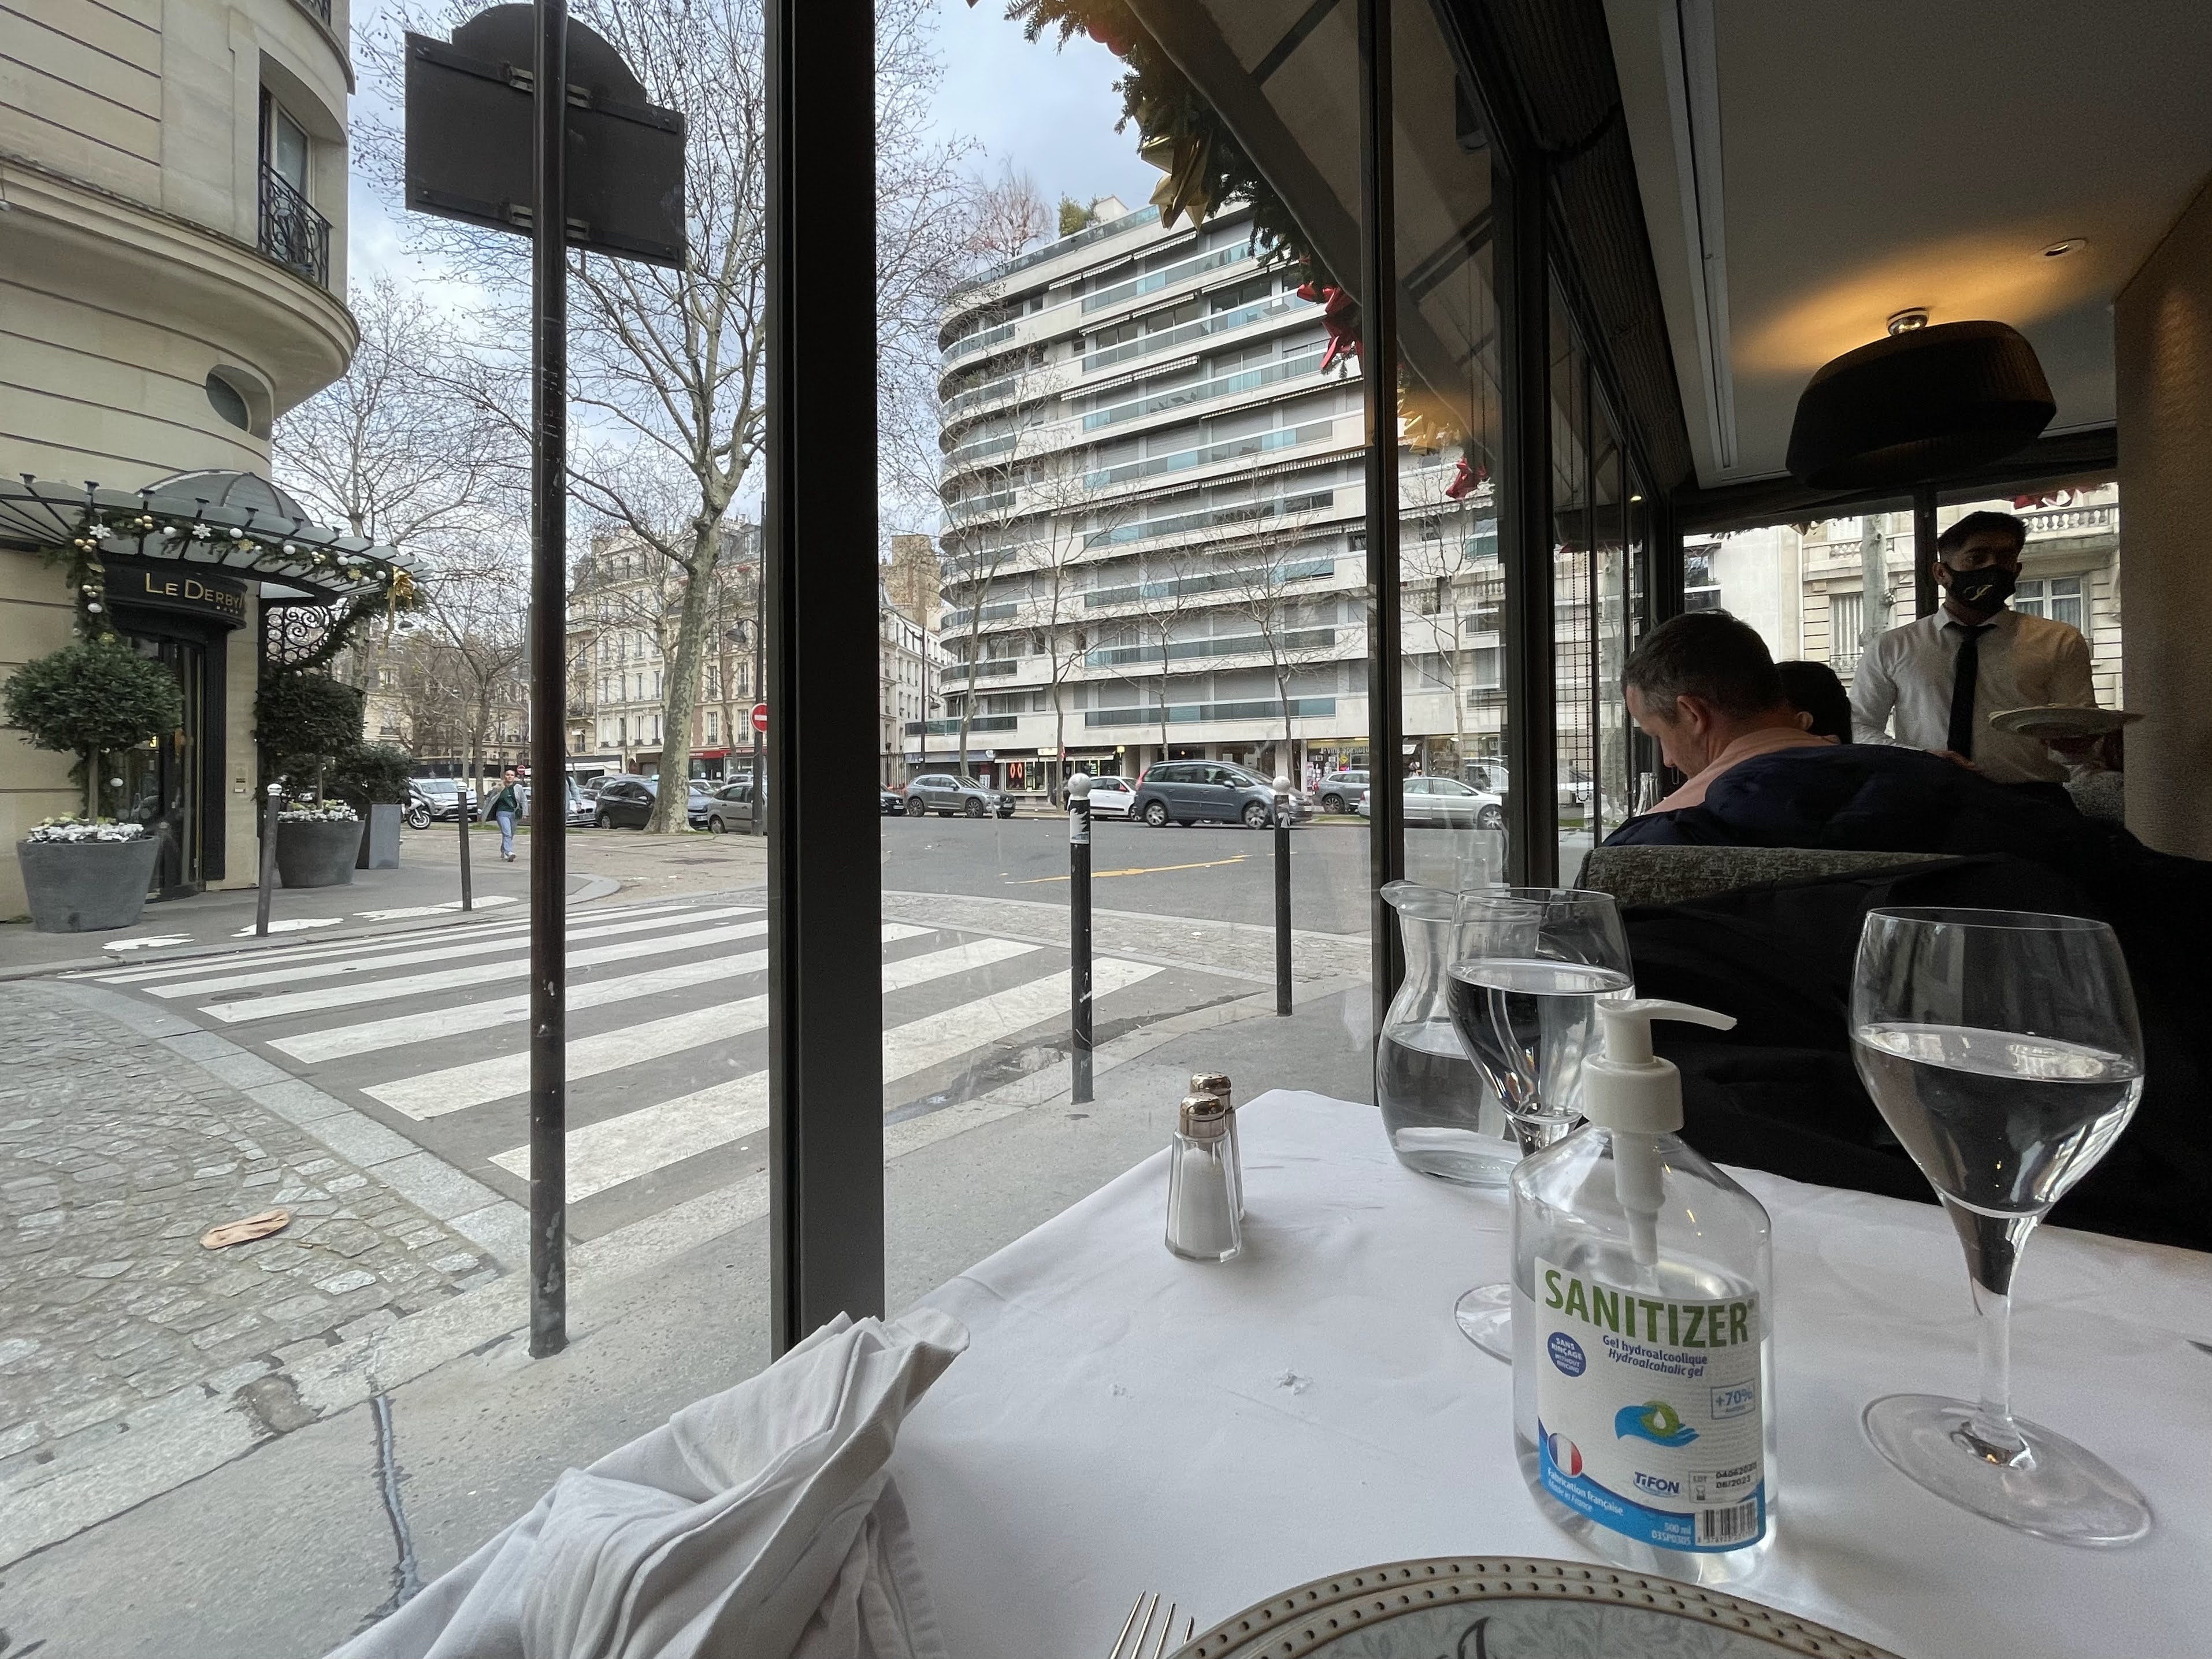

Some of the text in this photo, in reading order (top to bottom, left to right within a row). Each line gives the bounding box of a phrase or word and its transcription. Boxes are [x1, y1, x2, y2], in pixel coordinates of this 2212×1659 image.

[184, 578, 239, 608] DERBY
[1545, 1269, 1749, 1348] SANITIZER
[1602, 1334, 1708, 1367] Gel hydroalcoolique
[1608, 1348, 1704, 1379] Hydroalcoholic gel
[1715, 1388, 1753, 1406] +70%
[1547, 1467, 1624, 1516] Fabrication française
